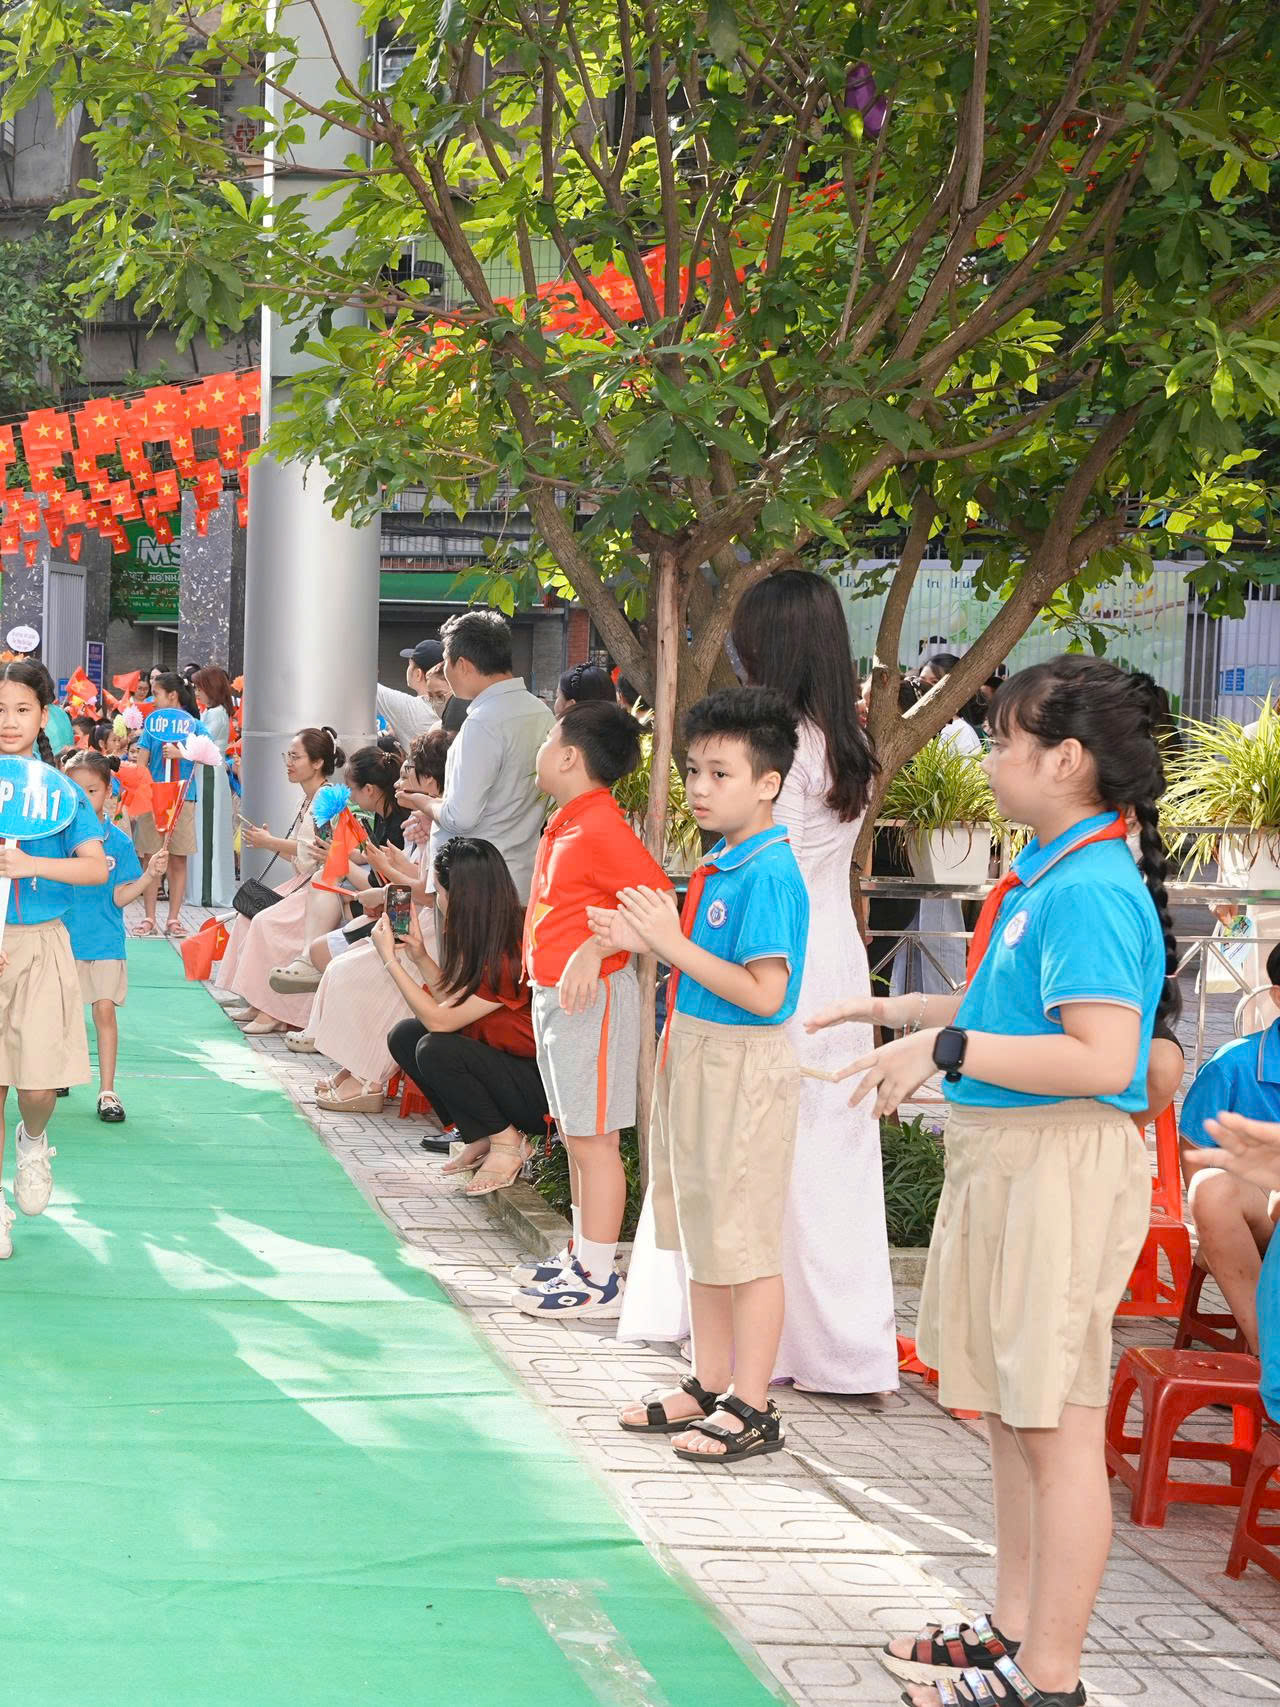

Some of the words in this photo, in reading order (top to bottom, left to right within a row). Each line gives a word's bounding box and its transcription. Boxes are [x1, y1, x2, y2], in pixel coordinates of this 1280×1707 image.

[149, 715, 168, 733] LỚP
[172, 719, 190, 734] 1A2
[22, 786, 62, 822] 1A1
